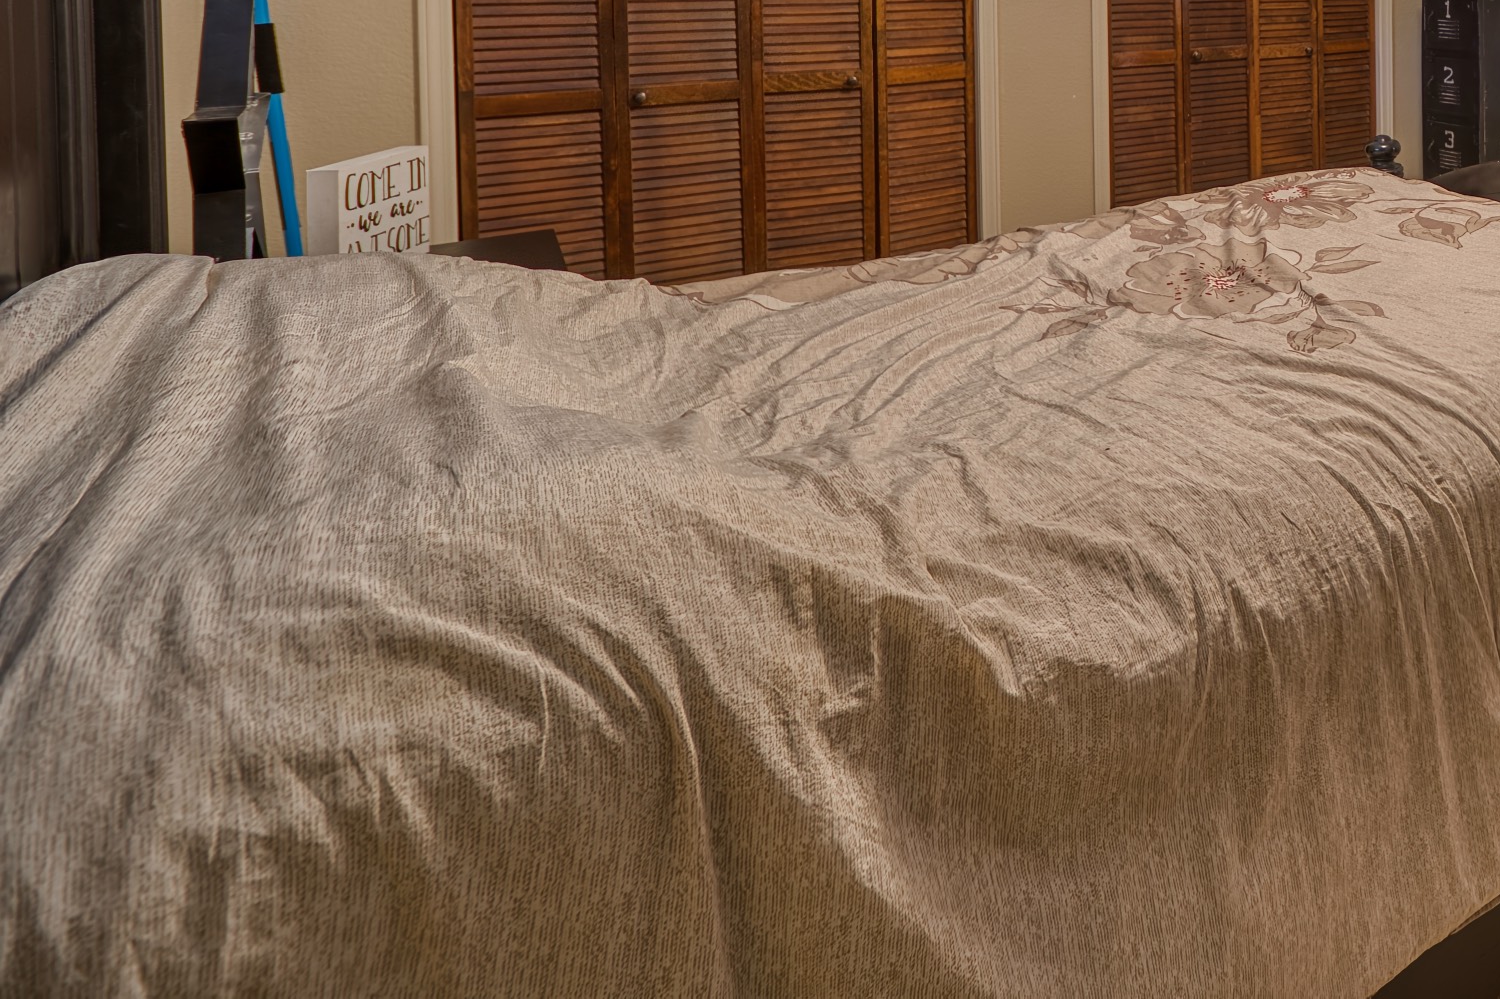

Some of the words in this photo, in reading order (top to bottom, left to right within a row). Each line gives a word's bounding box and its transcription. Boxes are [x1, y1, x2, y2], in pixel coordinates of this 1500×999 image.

[1444, 0, 1452, 19] 1
[1443, 66, 1455, 85] 2
[1444, 130, 1455, 149] 3
[344, 161, 401, 211] COME
[407, 156, 428, 194] IN
[358, 210, 382, 233] we
[389, 200, 416, 218] are
